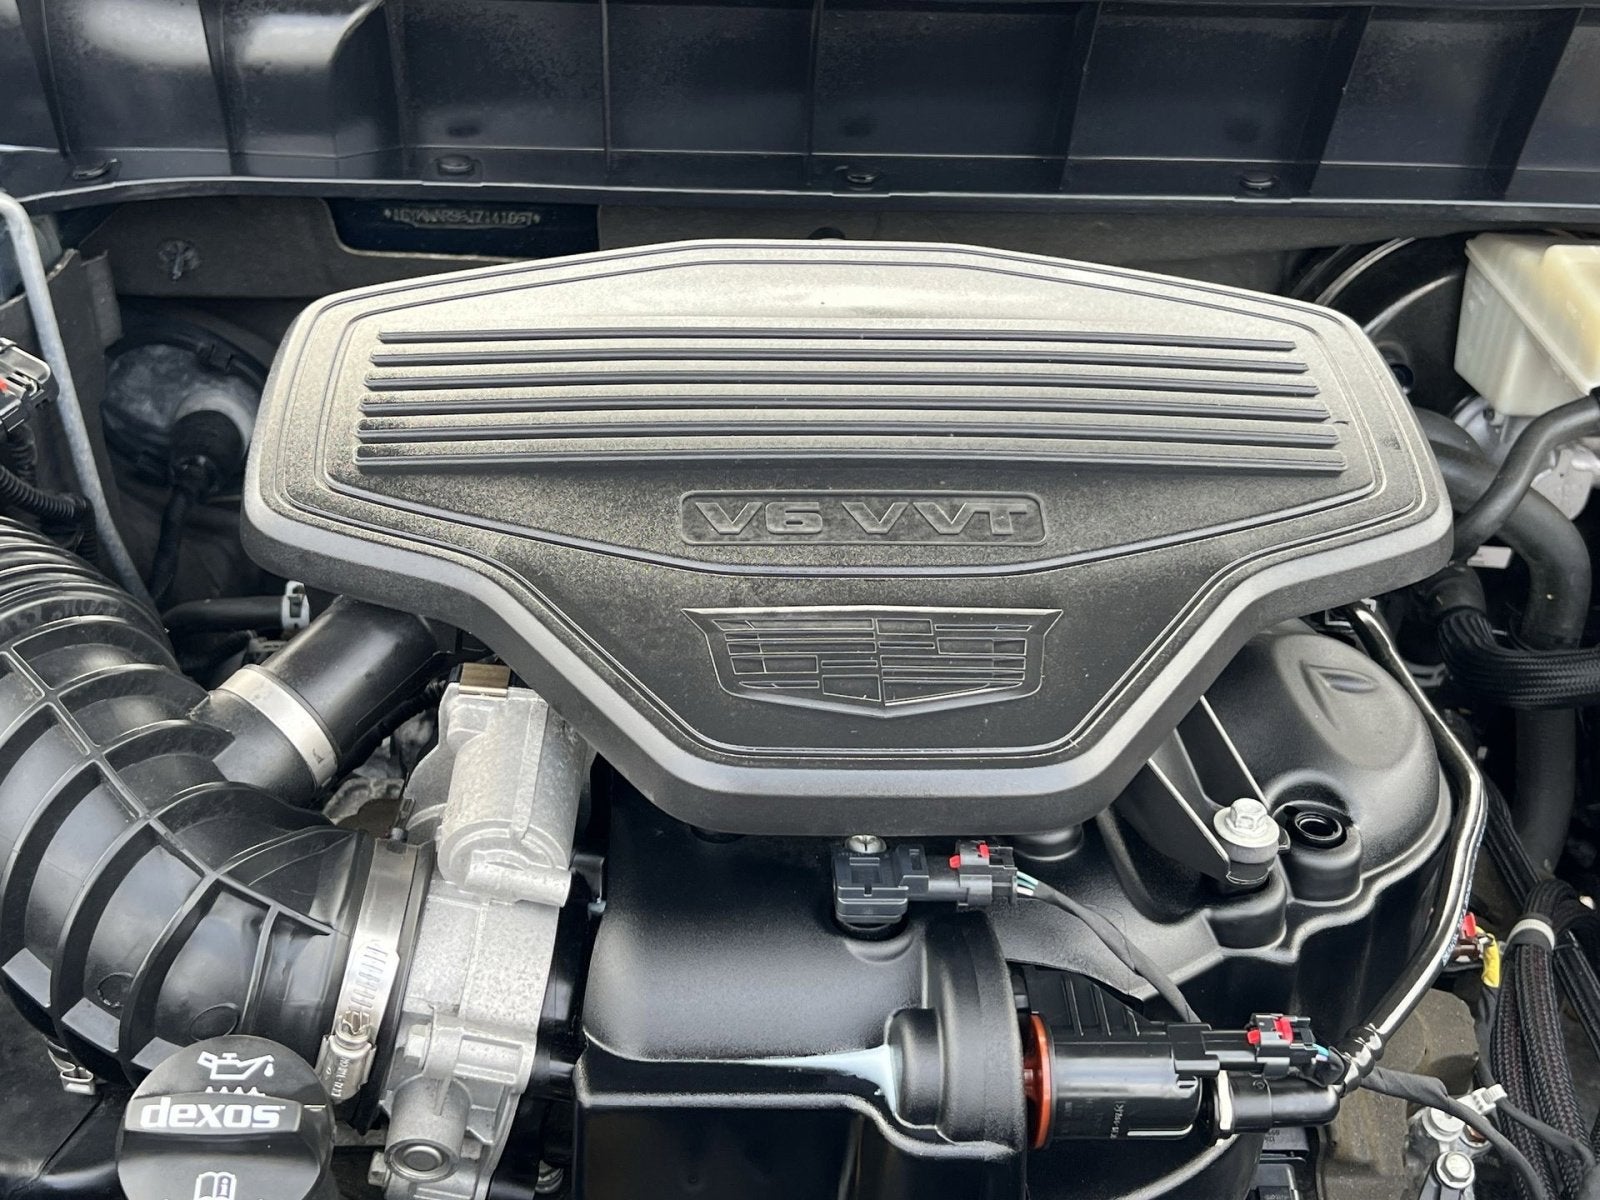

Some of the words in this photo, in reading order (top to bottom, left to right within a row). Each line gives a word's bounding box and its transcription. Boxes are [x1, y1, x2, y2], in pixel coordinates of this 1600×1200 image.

[695, 501, 824, 535] V6
[841, 501, 1028, 536] VVT
[140, 1096, 280, 1129] dexos
